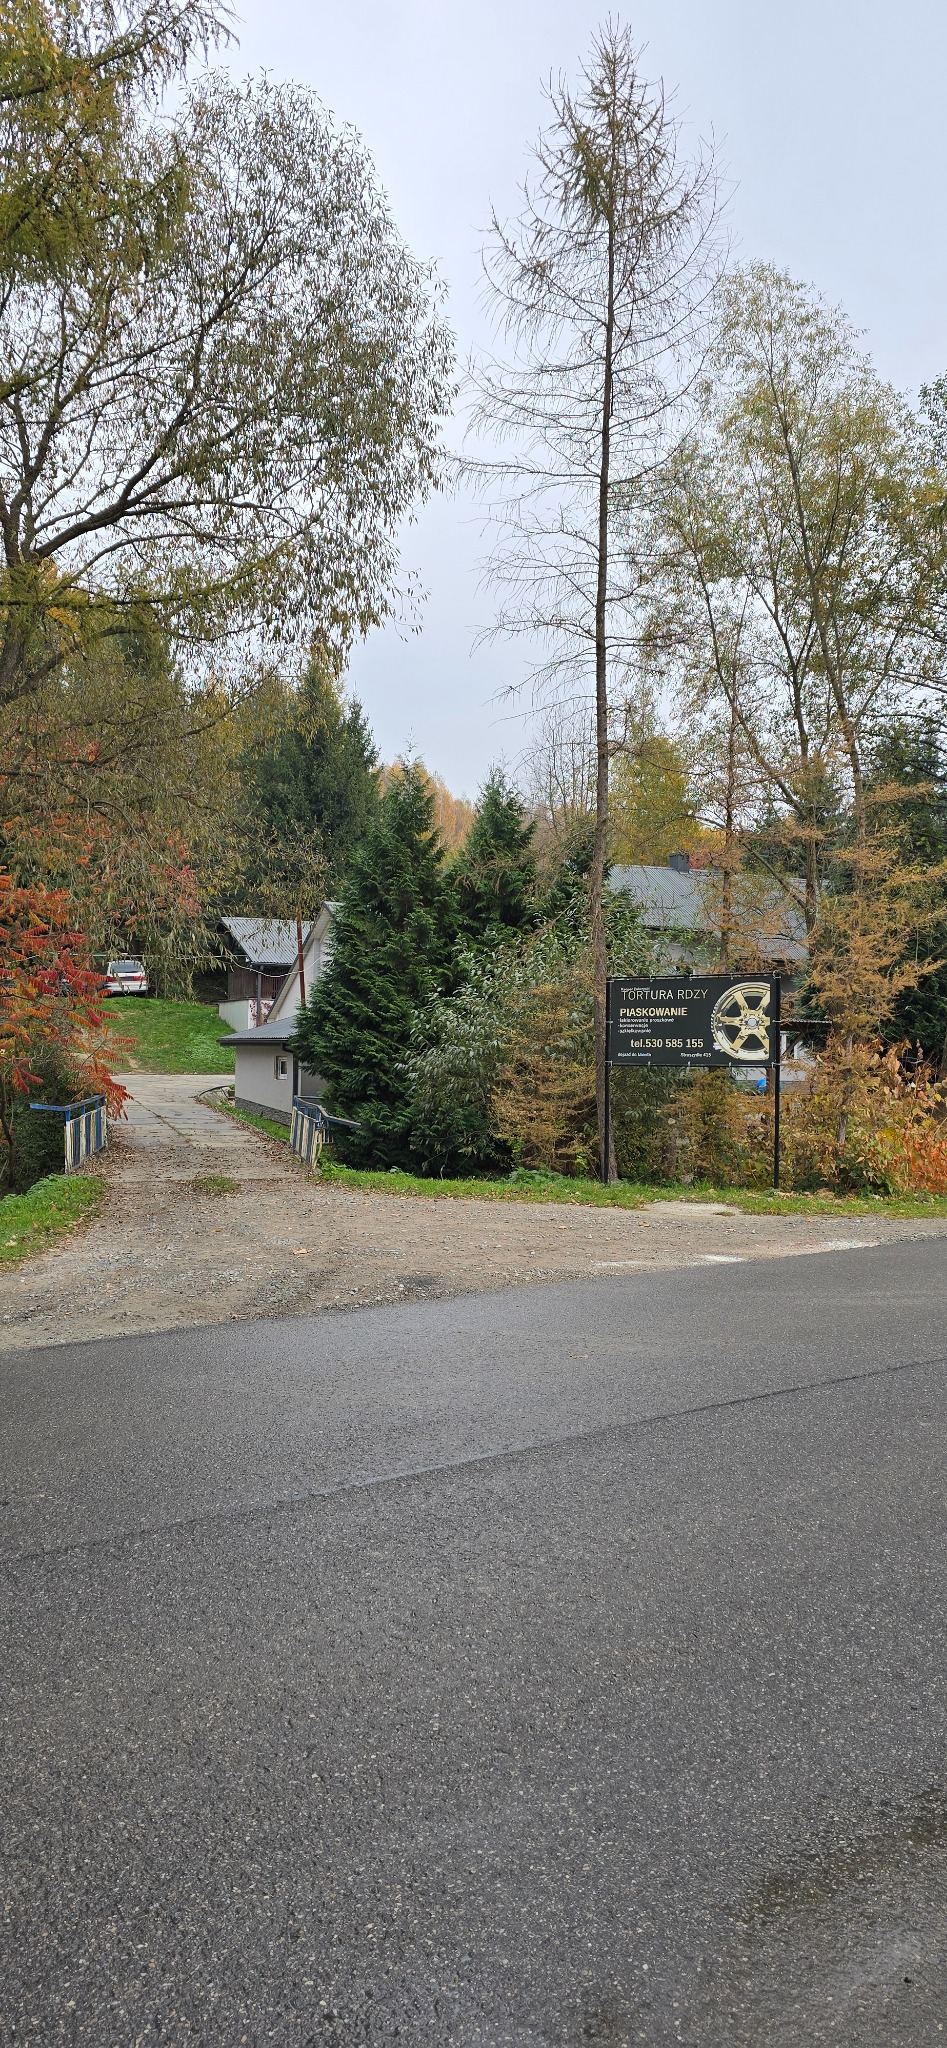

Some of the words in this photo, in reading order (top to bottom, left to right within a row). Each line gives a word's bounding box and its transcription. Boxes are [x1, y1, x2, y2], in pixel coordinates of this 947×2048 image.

[621, 990, 674, 1001] TORTURA
[677, 989, 708, 1000] RDZY
[620, 1007, 688, 1017] PIASKOWANIE
[630, 1038, 663, 1048] tel.530
[665, 1038, 683, 1048] 585
[685, 1038, 704, 1048] 155
